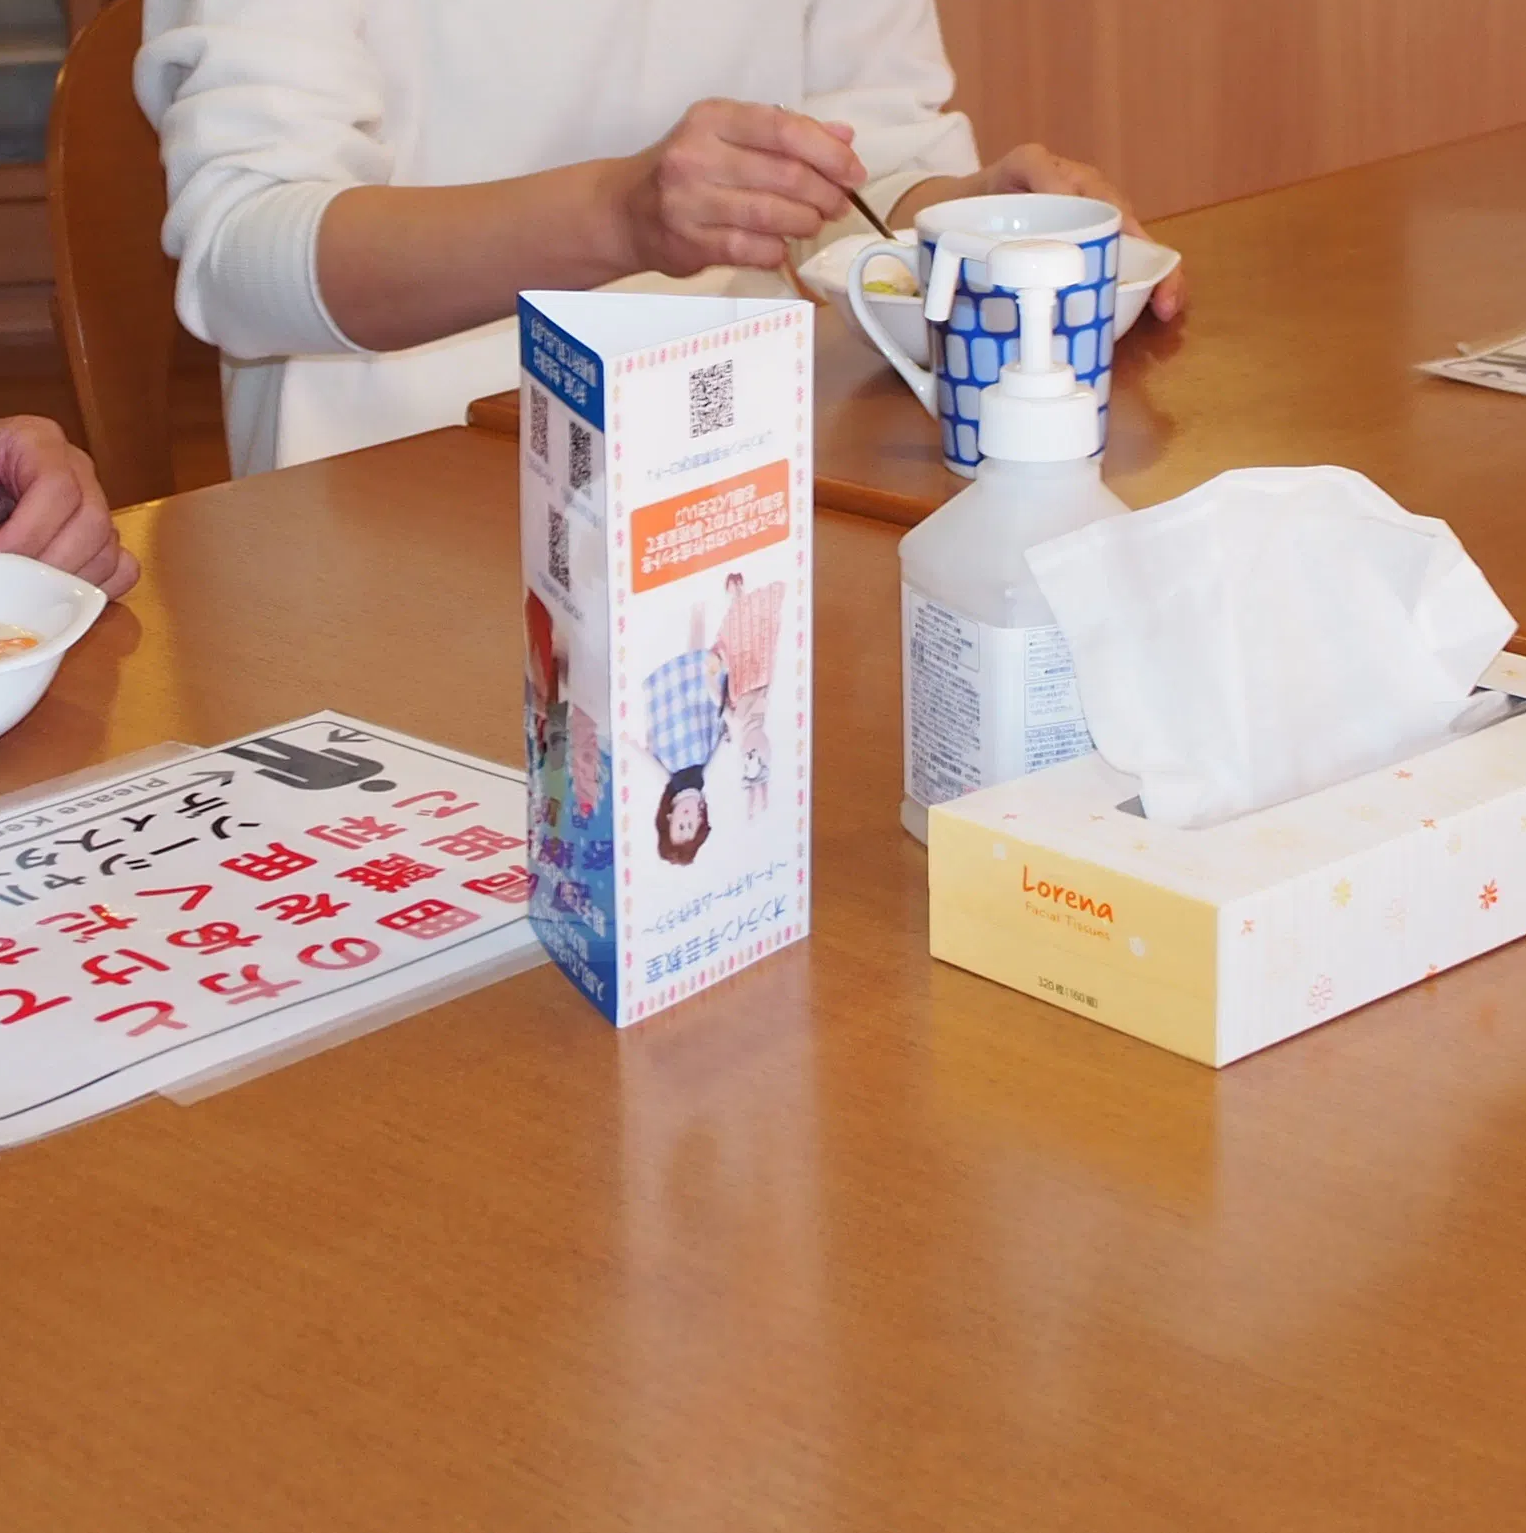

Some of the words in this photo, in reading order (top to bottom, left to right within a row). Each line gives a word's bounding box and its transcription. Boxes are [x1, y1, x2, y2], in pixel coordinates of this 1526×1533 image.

[57, 777, 170, 815] Please
[1022, 864, 1114, 924] Lorena
[1025, 900, 1061, 924] Facial
[1065, 914, 1111, 942] Tissues
